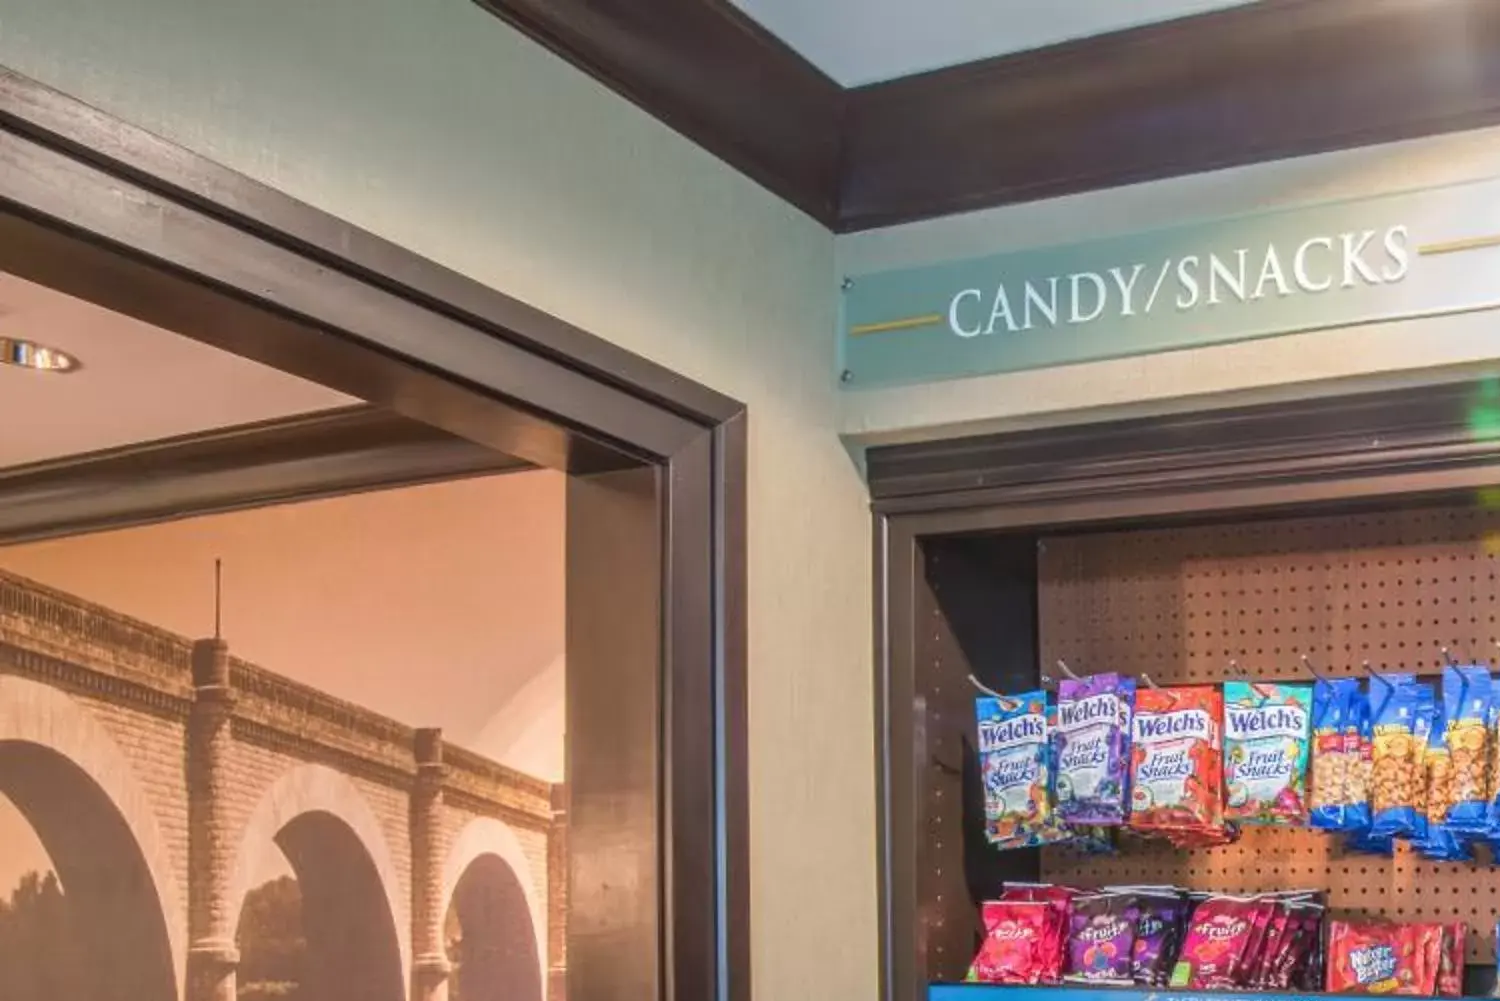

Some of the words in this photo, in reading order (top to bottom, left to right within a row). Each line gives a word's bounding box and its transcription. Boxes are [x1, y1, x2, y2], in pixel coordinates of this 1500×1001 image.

[947, 225, 1409, 339] CANDY/SNACKS
[1060, 697, 1116, 725] Welch's
[1138, 711, 1205, 737] Welch's
[1228, 707, 1302, 732] Welch's
[980, 718, 1044, 747] Welch's
